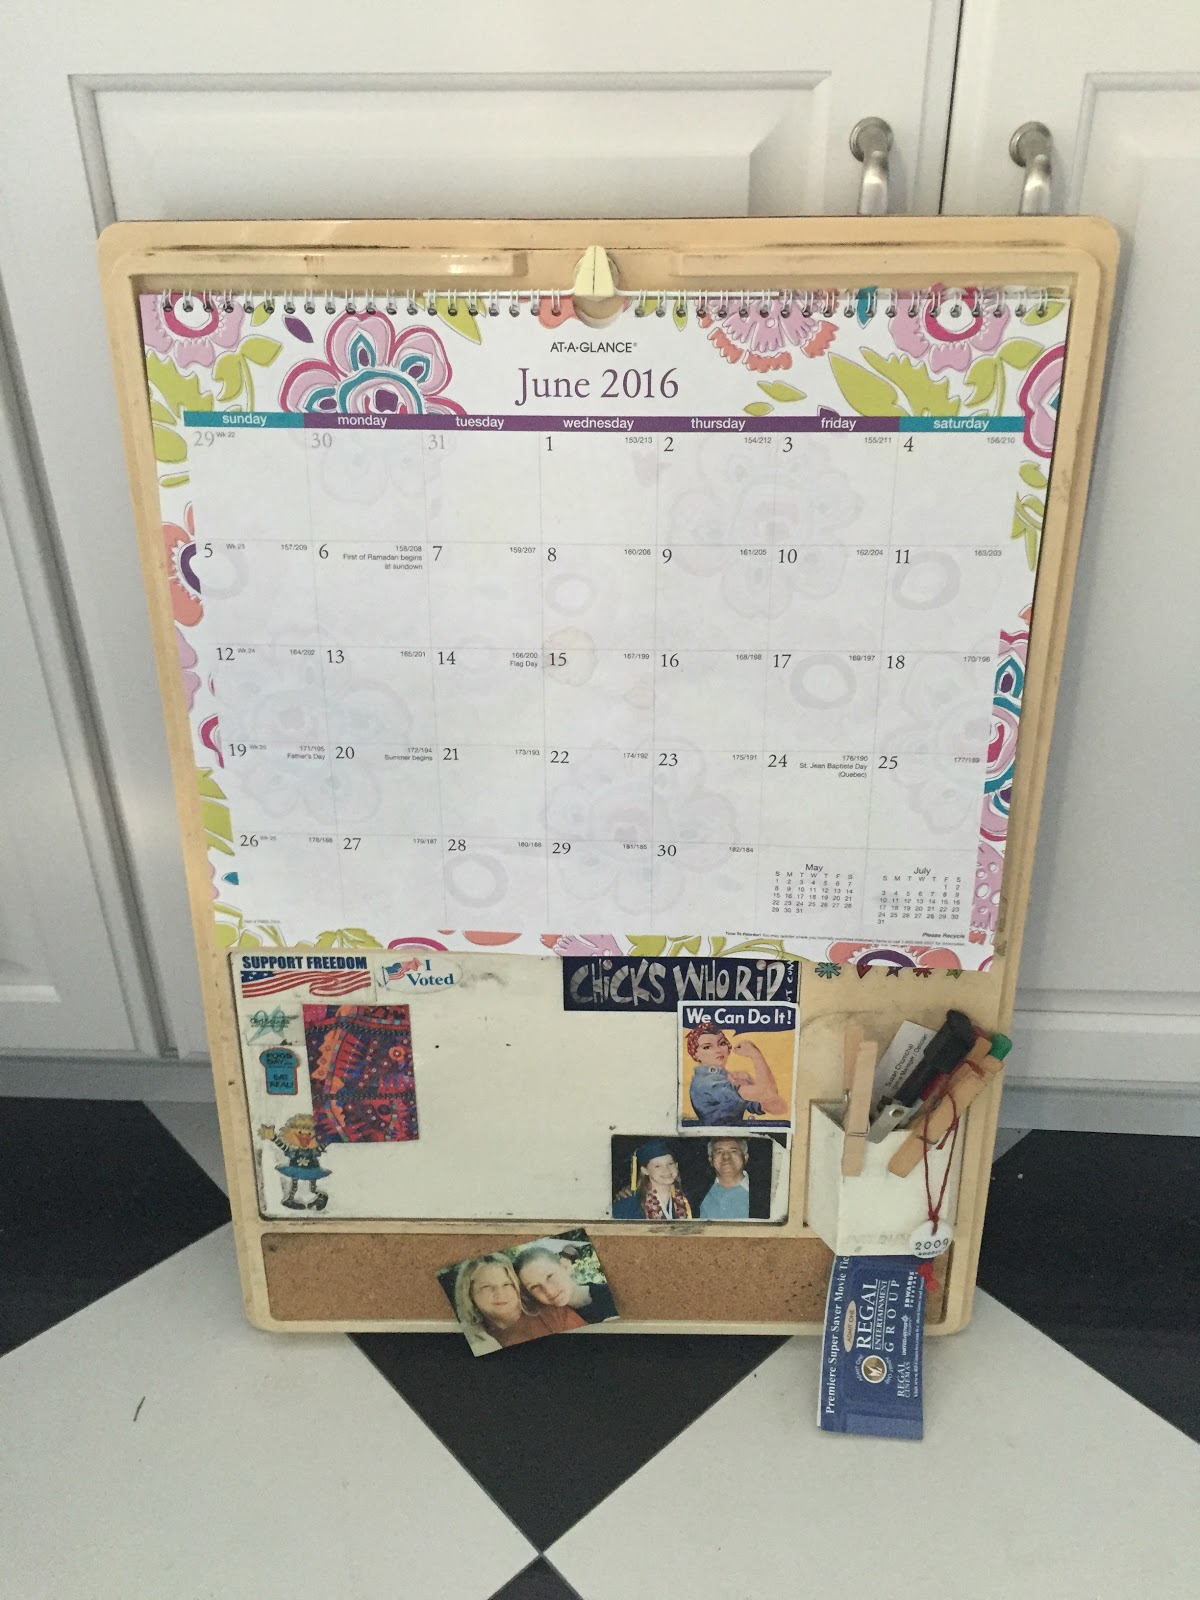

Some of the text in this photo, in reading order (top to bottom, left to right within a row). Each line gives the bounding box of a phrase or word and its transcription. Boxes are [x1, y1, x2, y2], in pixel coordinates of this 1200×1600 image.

[515, 368, 678, 406] June 2016
[222, 413, 267, 427] sunday
[337, 414, 387, 429] monday
[455, 416, 504, 430] tuesday
[562, 416, 634, 431] wednesday
[691, 417, 746, 431] thursday
[820, 417, 857, 432] friday
[933, 417, 990, 432] saturday
[194, 431, 214, 447] 29
[312, 433, 332, 448] 30
[429, 435, 445, 450] 31
[546, 436, 552, 451] 1
[664, 437, 674, 451] 2
[783, 437, 793, 452] 3
[904, 437, 913, 452] 4
[205, 543, 213, 558] 5
[319, 544, 328, 559] 6
[433, 546, 442, 561] 7
[548, 547, 556, 561] 8
[663, 549, 672, 563] 9
[779, 549, 797, 563] 10
[896, 550, 909, 564] 11
[216, 648, 235, 660] 12
[327, 650, 344, 663] 13
[438, 651, 455, 665] 14
[550, 653, 566, 666] 15
[662, 653, 679, 667] 16
[774, 654, 791, 668] 17
[888, 655, 904, 669] 18
[229, 744, 246, 757] 19
[336, 746, 354, 759] 20
[443, 748, 458, 760] 21
[551, 751, 569, 763] 22
[659, 753, 678, 766] 23
[768, 754, 787, 767] 24
[878, 756, 897, 769] 25
[240, 835, 258, 847] 26
[344, 838, 361, 850] 27
[448, 839, 466, 851] 28
[553, 843, 571, 854] 29
[658, 845, 676, 856] 30
[806, 864, 823, 872] May
[914, 867, 931, 876] July
[242, 956, 367, 969] SUPPORT FREEDOM
[426, 960, 431, 971] I
[407, 973, 454, 986] Voted
[672, 960, 730, 1003] WHO
[686, 1008, 792, 1025] We Can Do It!
[915, 1238, 949, 1250] 2009
[834, 1274, 844, 1301] Movie
[831, 1304, 842, 1332] Saver
[856, 1279, 878, 1349] REGAL
[875, 1280, 888, 1350] ENTERTAINMENT
[828, 1332, 840, 1365] Super
[897, 1363, 906, 1397] REGAL
[826, 1367, 837, 1414] Premiere
